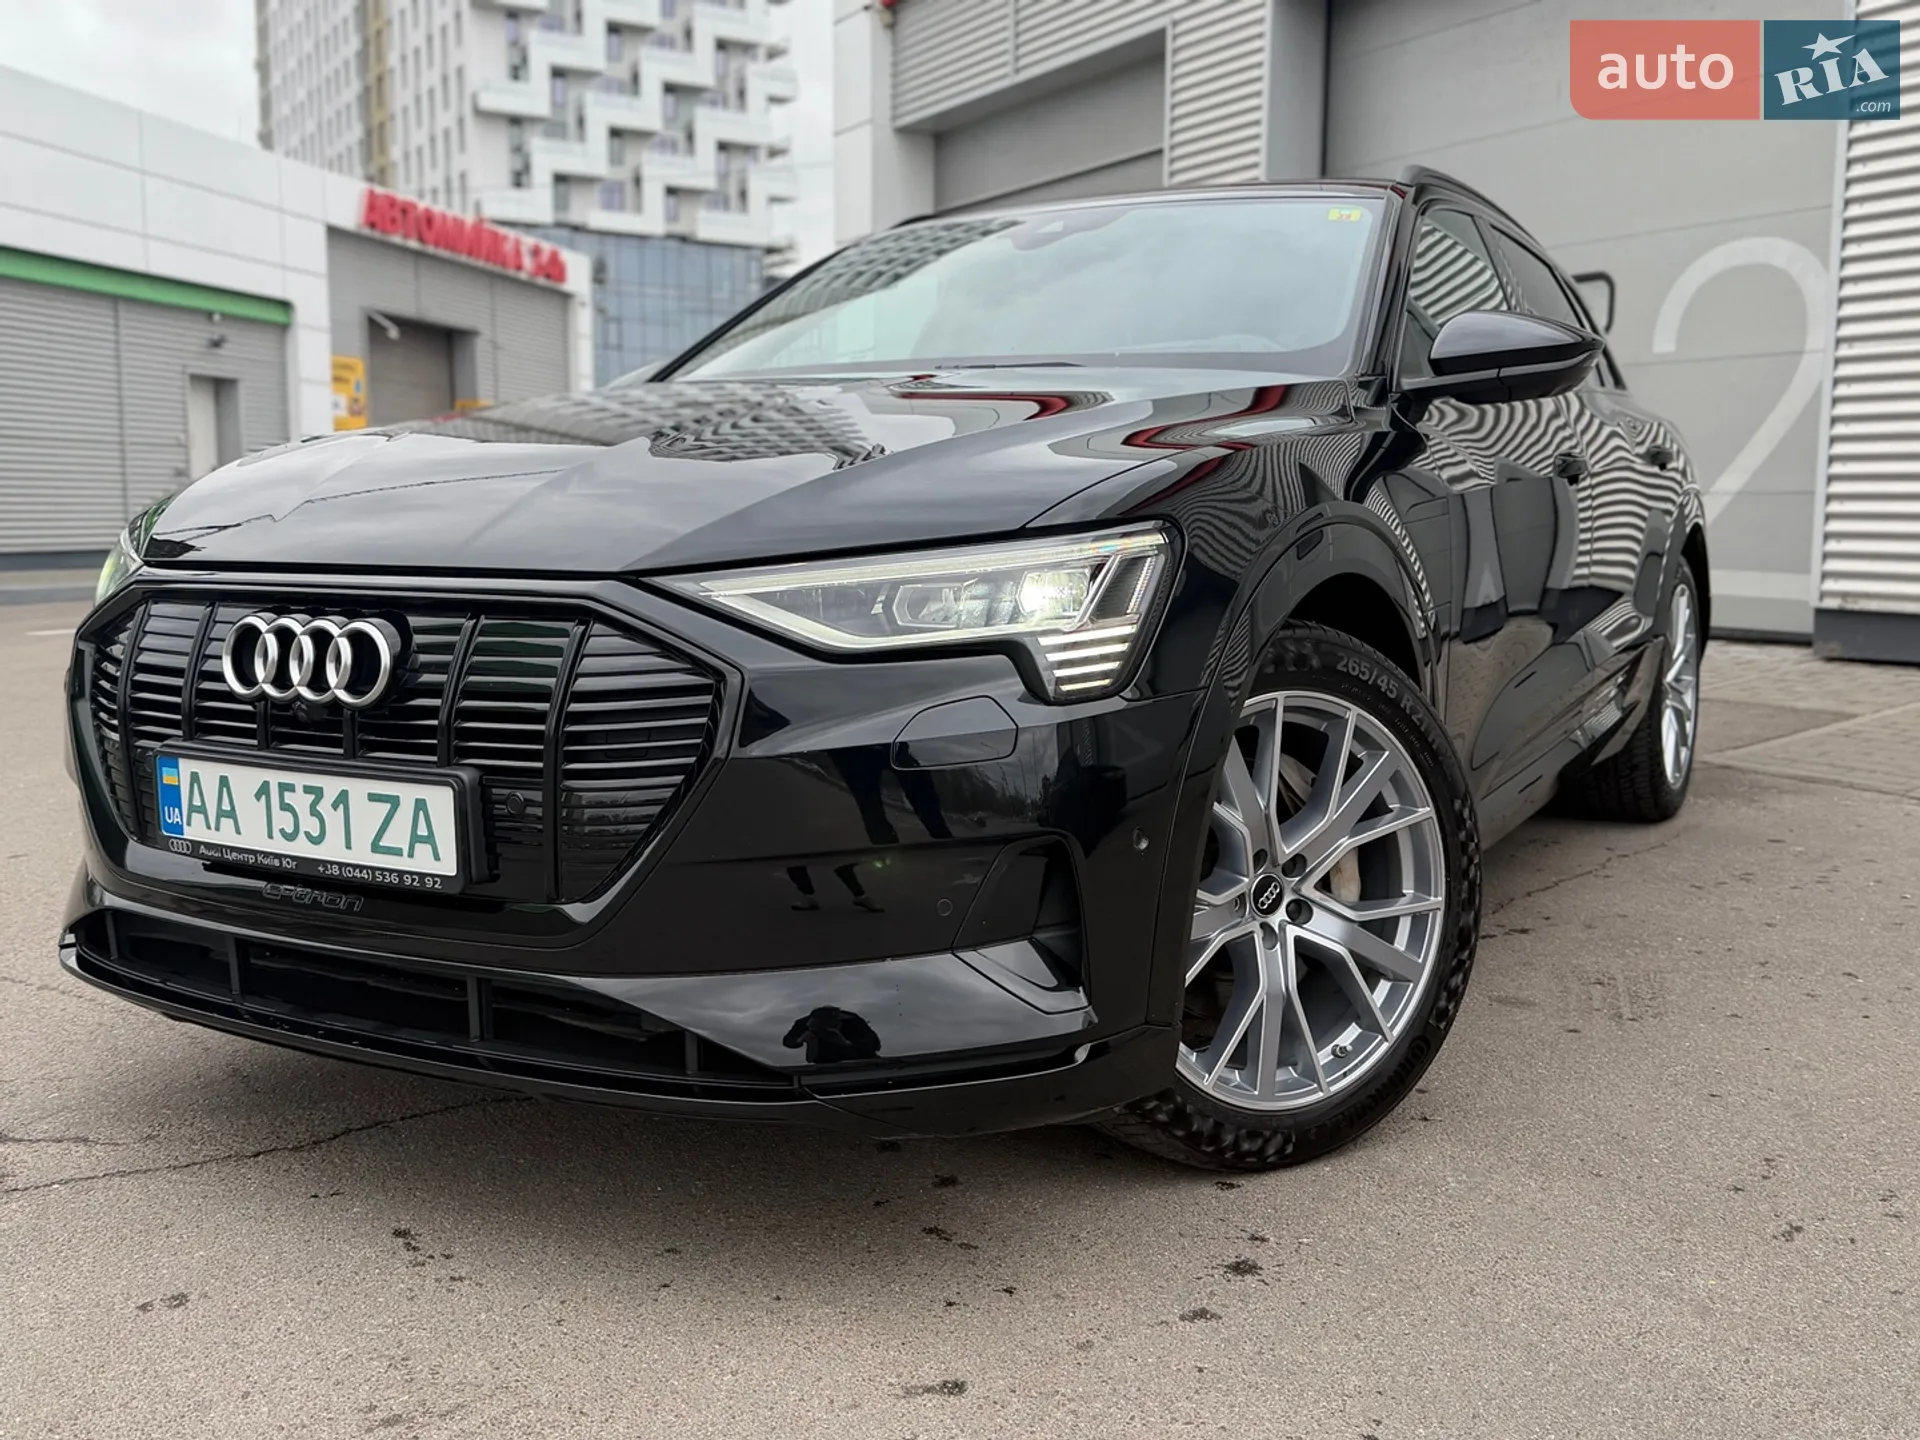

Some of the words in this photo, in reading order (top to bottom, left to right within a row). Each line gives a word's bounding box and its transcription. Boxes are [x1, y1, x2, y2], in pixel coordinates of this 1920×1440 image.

[1336, 653, 1398, 699] 265/45
[164, 805, 182, 826] UA
[185, 770, 243, 836] AA
[253, 779, 353, 852] 1531
[366, 791, 442, 863] ZA
[198, 844, 221, 858] Audi
[222, 847, 256, 864] Центр
[257, 853, 281, 867] Київ
[281, 857, 298, 869] Юг
[317, 862, 341, 876] +38
[341, 865, 373, 881] (044)
[374, 869, 399, 884] 536
[402, 873, 421, 888] 92
[424, 876, 443, 890] 92
[262, 883, 365, 912] e-tron
